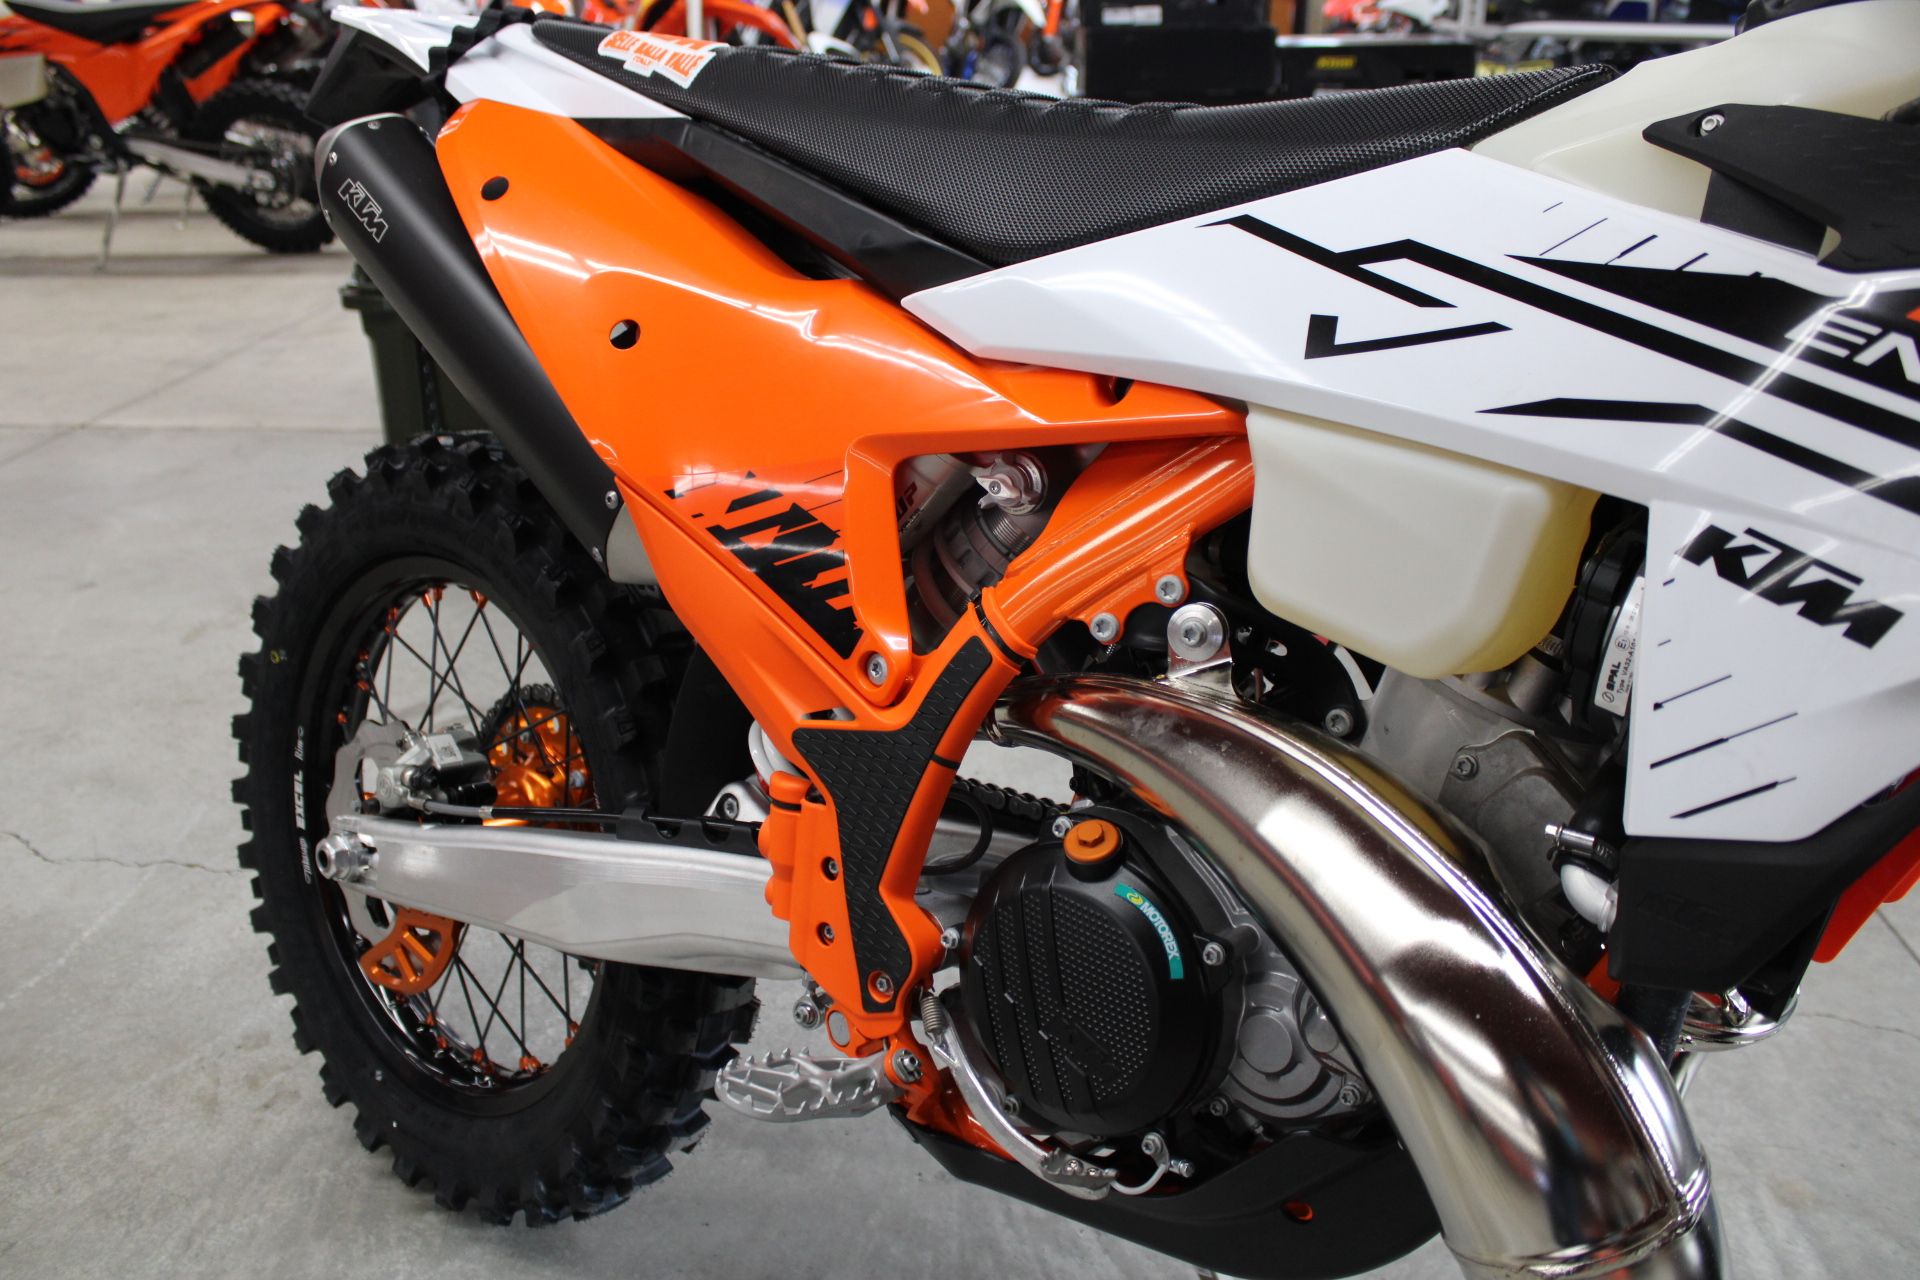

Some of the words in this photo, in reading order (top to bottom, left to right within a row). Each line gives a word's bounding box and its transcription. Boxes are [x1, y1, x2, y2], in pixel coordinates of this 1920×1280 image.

[663, 51, 704, 77] VALLE
[338, 178, 388, 243] KTM
[1674, 525, 1904, 649] KTM
[1606, 661, 1621, 691] SPAL
[294, 770, 306, 830] EXCEL
[1140, 901, 1180, 960] MOTOREX
